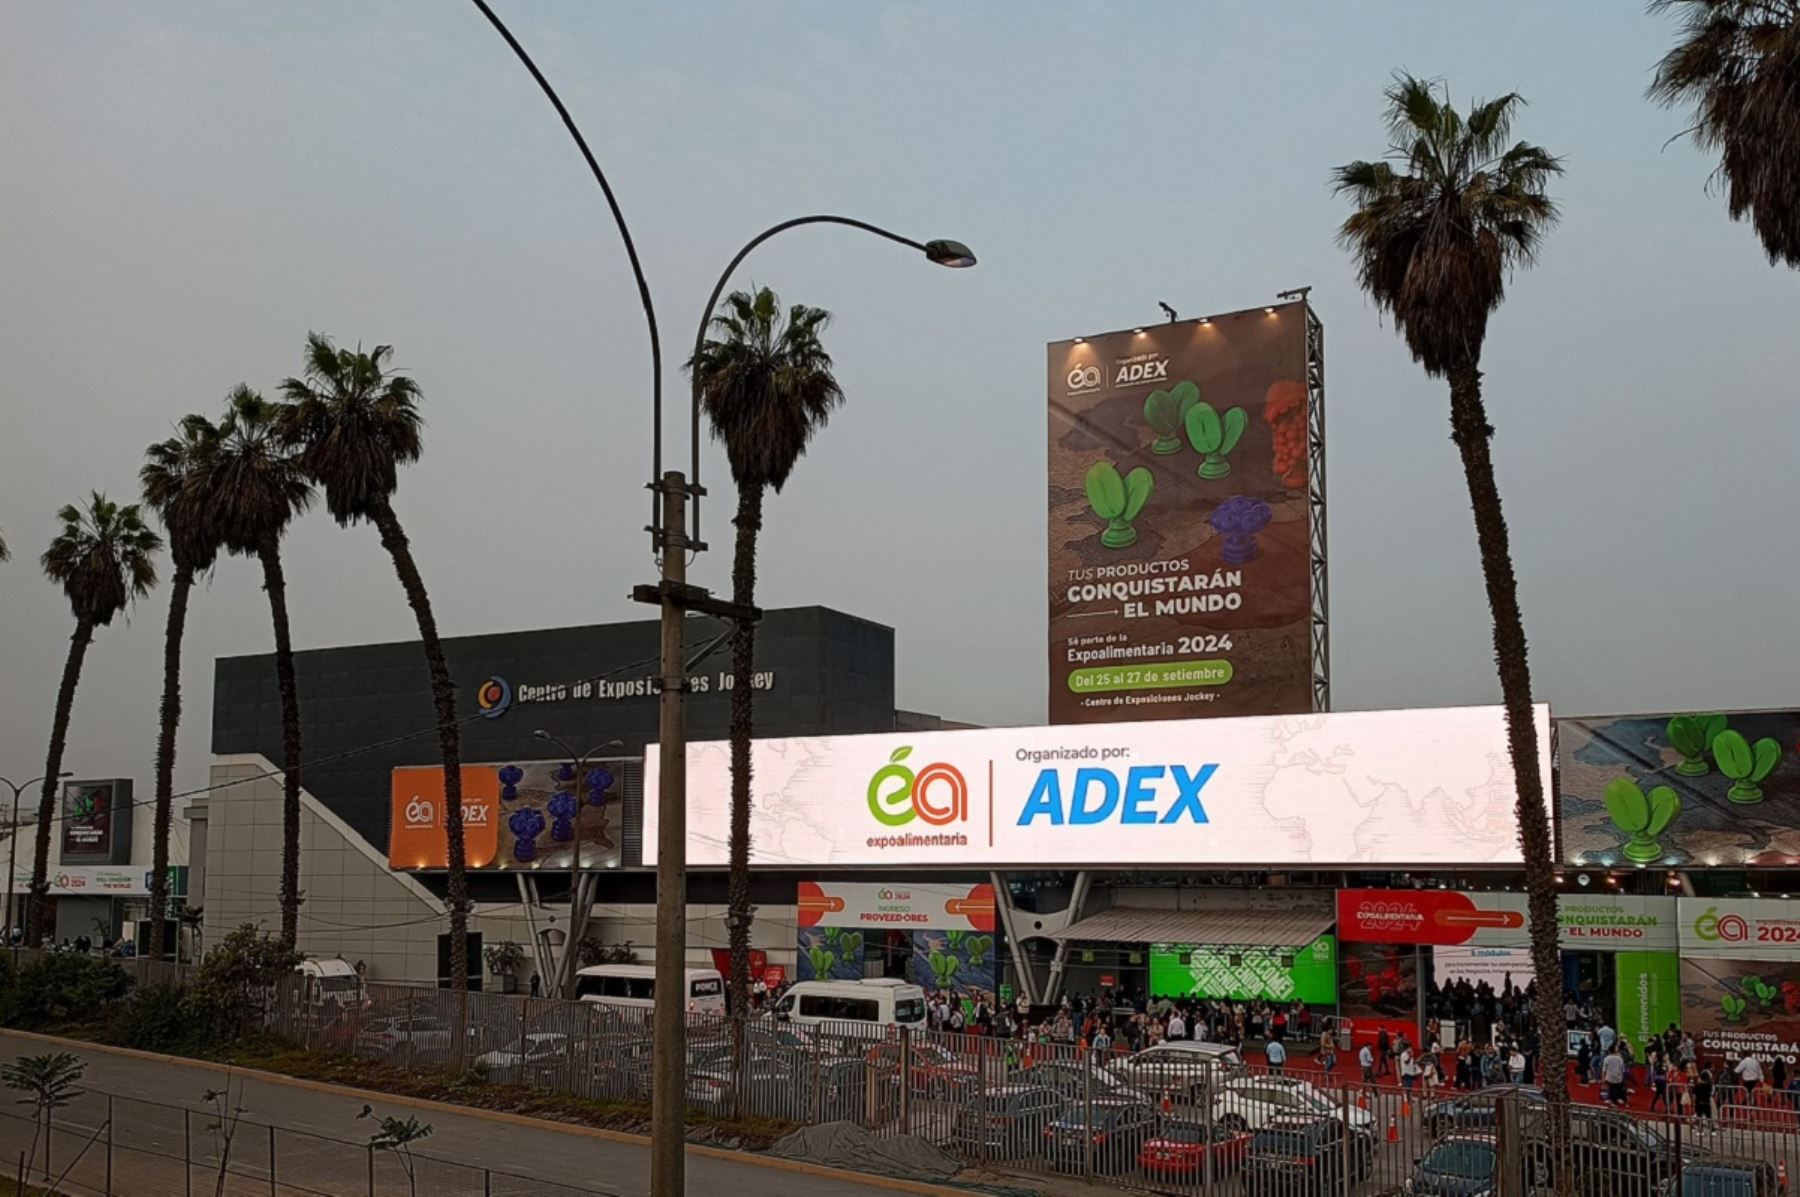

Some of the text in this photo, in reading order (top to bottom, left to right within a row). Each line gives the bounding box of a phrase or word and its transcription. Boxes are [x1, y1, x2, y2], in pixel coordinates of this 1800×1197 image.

[1115, 359, 1170, 383] ADEX
[1068, 559, 1190, 581] TUS PRODUCTOS
[1067, 568, 1242, 603] CONQUISTARÁN
[1123, 592, 1242, 618] EL MUNDO
[1067, 634, 1233, 663] Expoalimentaria 2024
[1081, 636, 1104, 646] parte
[1106, 634, 1117, 643] de
[1119, 633, 1128, 642] la
[1075, 667, 1225, 687] Del 25 al 27 de setiembre
[518, 671, 774, 702] Centro de Exposies Joey
[1085, 692, 1215, 707] Centro de Exposiciones Jockey
[1016, 746, 1130, 764] Organizado por:
[1016, 763, 1220, 826] ADEX
[460, 805, 489, 822] DEX
[866, 831, 968, 849] expoalimentaria
[860, 913, 929, 922] PROVEEDORES
[1565, 905, 1624, 913] PRODUCTOS
[1569, 927, 1643, 938] EL MUNDO
[695, 981, 718, 991] PONCE
[1637, 972, 1649, 1042] Bienvenidos
[1702, 1030, 1778, 1041] TUS PRODUCTOS
[1726, 1051, 1741, 1061] EL
